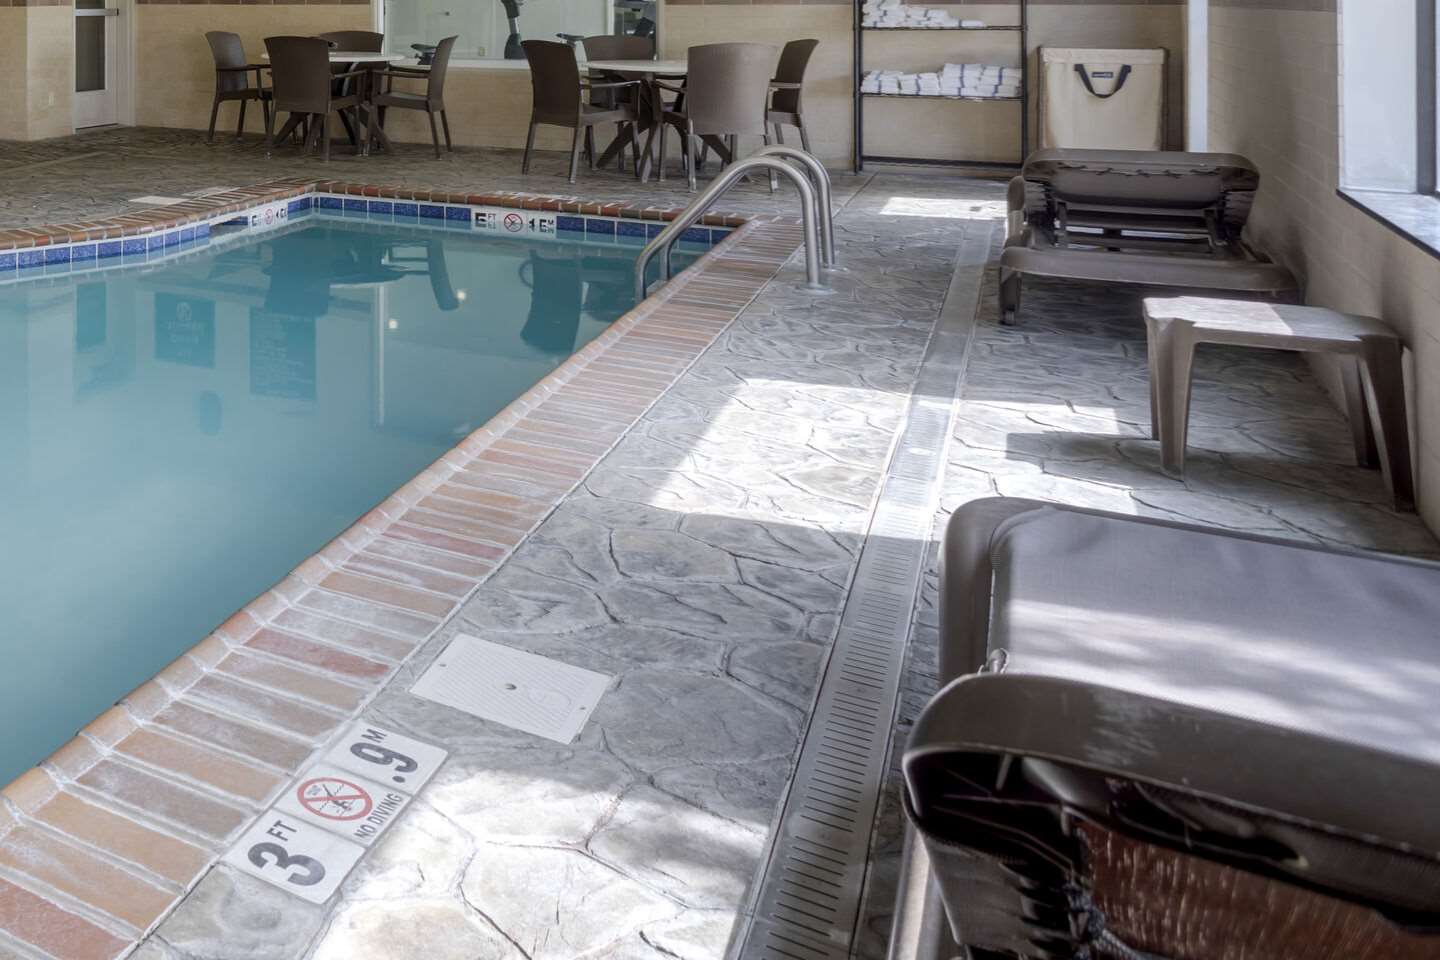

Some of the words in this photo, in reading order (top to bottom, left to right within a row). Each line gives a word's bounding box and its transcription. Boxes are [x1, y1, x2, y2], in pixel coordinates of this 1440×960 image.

[361, 728, 388, 743] M
[266, 820, 298, 841] FT
[353, 824, 377, 839] NO
[366, 792, 403, 825] DIVING
[247, 842, 326, 886] 3
